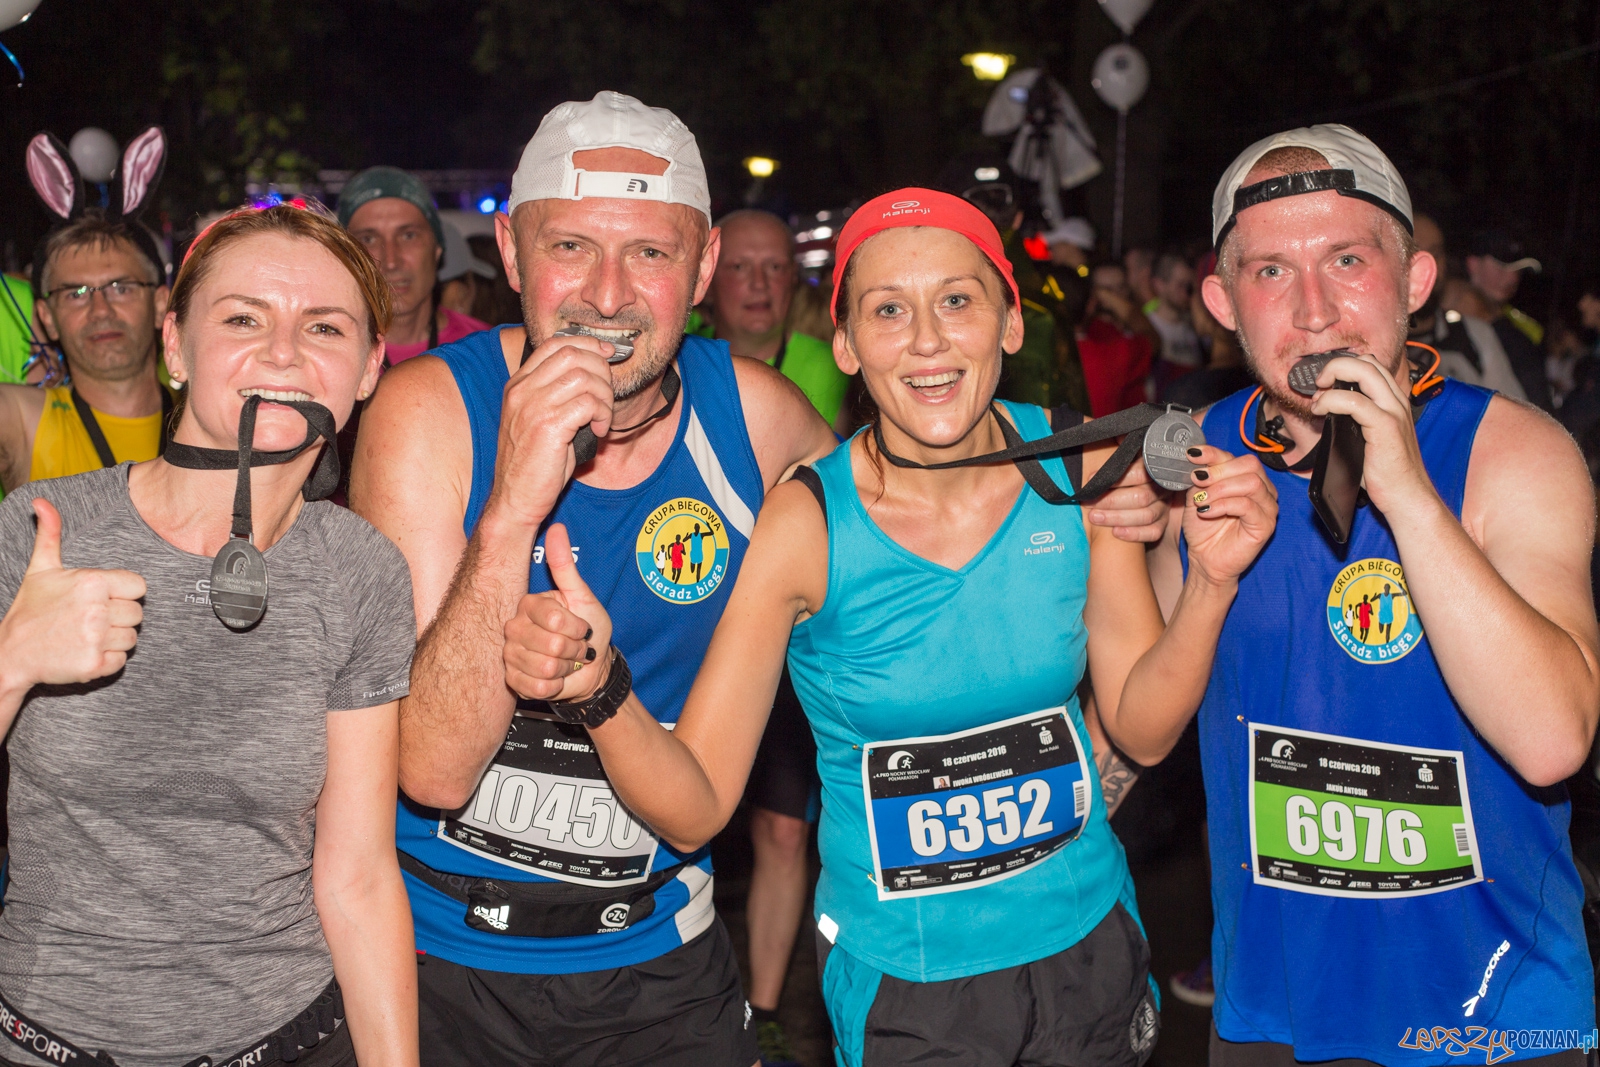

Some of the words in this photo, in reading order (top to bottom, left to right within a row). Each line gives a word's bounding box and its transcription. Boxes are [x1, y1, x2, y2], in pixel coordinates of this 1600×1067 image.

[882, 207, 931, 219] Kalenji
[644, 503, 676, 535] GRUPA
[677, 500, 721, 532] BIEGOWA
[1023, 542, 1065, 556] Kalenji
[645, 570, 692, 600] Sieradz
[696, 564, 722, 597] biega
[1334, 563, 1365, 594] GRUPA
[1333, 620, 1372, 659] Sieradz
[1378, 632, 1413, 659] biega
[543, 738, 553, 748] 18
[554, 740, 590, 753] czerwca
[942, 757, 952, 767] 18
[953, 751, 987, 766] czerwca
[987, 744, 1007, 759] 2016
[1318, 757, 1328, 768] 18
[1328, 759, 1361, 773] czerwca
[1361, 763, 1381, 776] 2016
[952, 777, 973, 788] IWONA
[1326, 783, 1344, 793] JAKUB
[1344, 786, 1369, 797] ANTOSIK
[473, 769, 644, 850] 10450
[907, 778, 1053, 857] 6352
[1285, 794, 1428, 867] 6976
[607, 909, 627, 922] PZU
[1477, 939, 1511, 998] BROOKS
